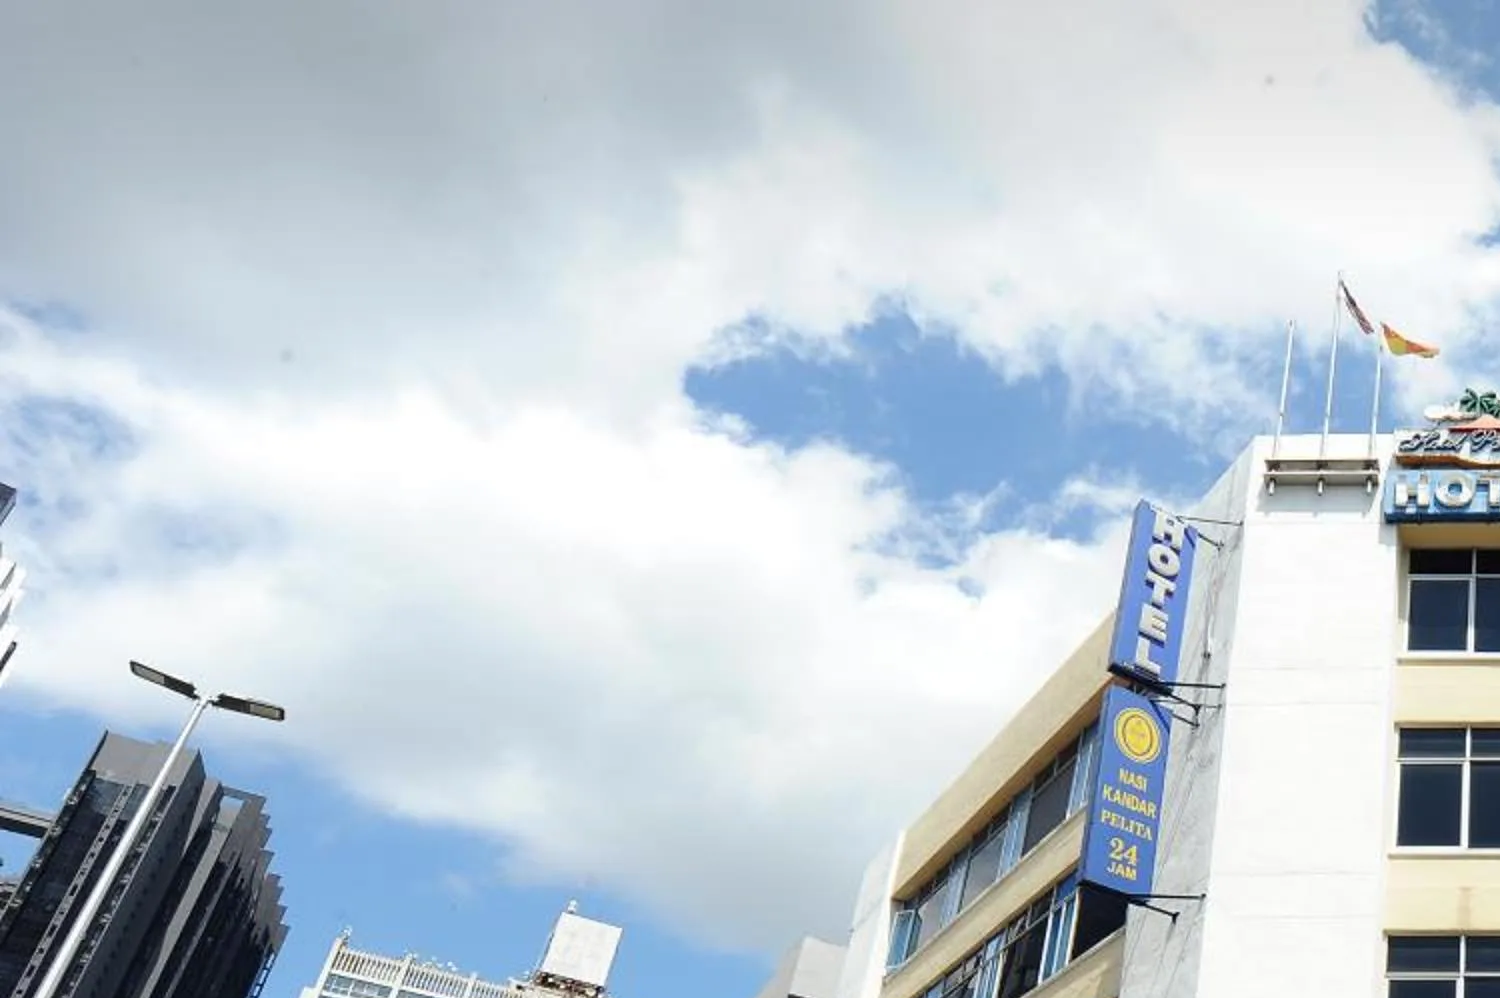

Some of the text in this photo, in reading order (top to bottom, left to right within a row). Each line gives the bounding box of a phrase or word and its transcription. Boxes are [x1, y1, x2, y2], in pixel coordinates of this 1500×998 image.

[1136, 507, 1185, 675] HOTEL
[1119, 767, 1148, 792] NASI
[1103, 784, 1157, 819] KANDAR
[1101, 807, 1153, 841] PELITA
[1110, 837, 1137, 866] 24
[1107, 861, 1137, 880] JAM
